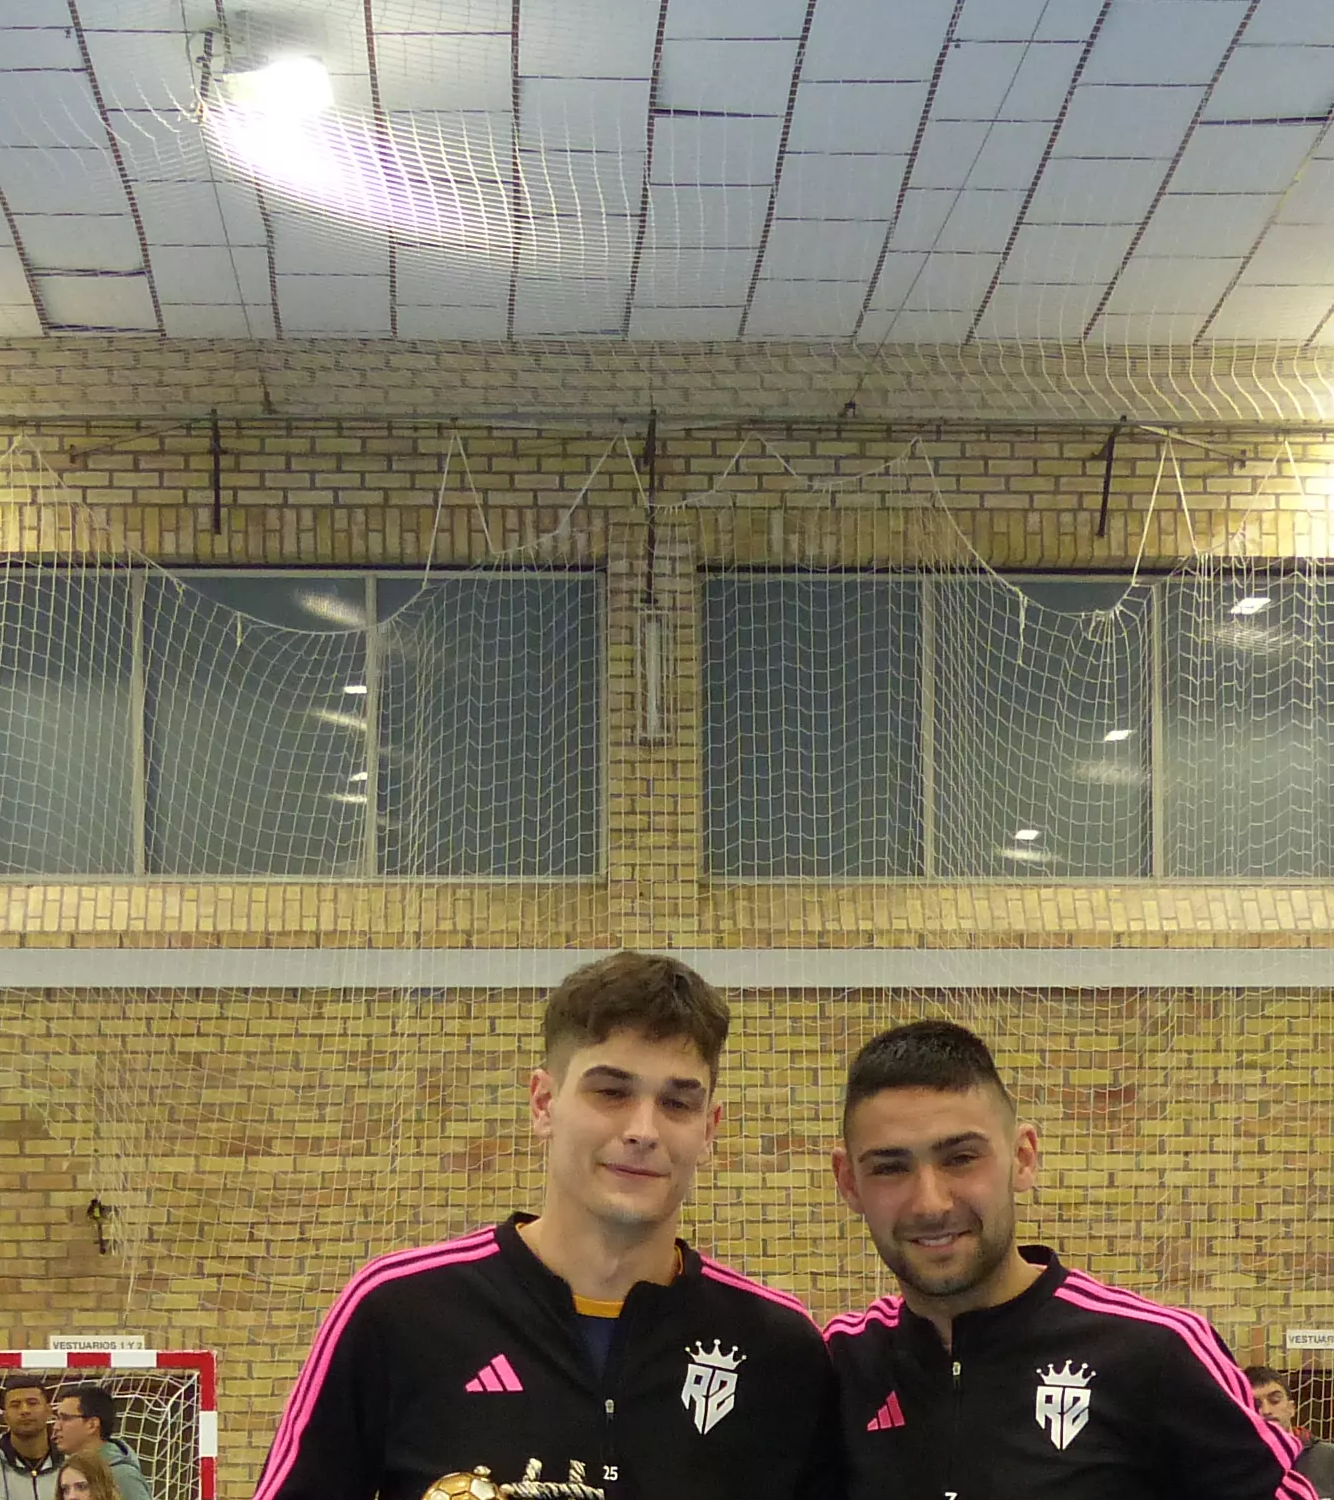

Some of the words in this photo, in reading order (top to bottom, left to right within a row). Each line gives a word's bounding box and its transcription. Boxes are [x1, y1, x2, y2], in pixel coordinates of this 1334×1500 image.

[53, 1341, 116, 1350] VESTUARIOS
[128, 1341, 134, 1350] Y
[137, 1341, 143, 1350] 2
[602, 1465, 618, 1481] 25
